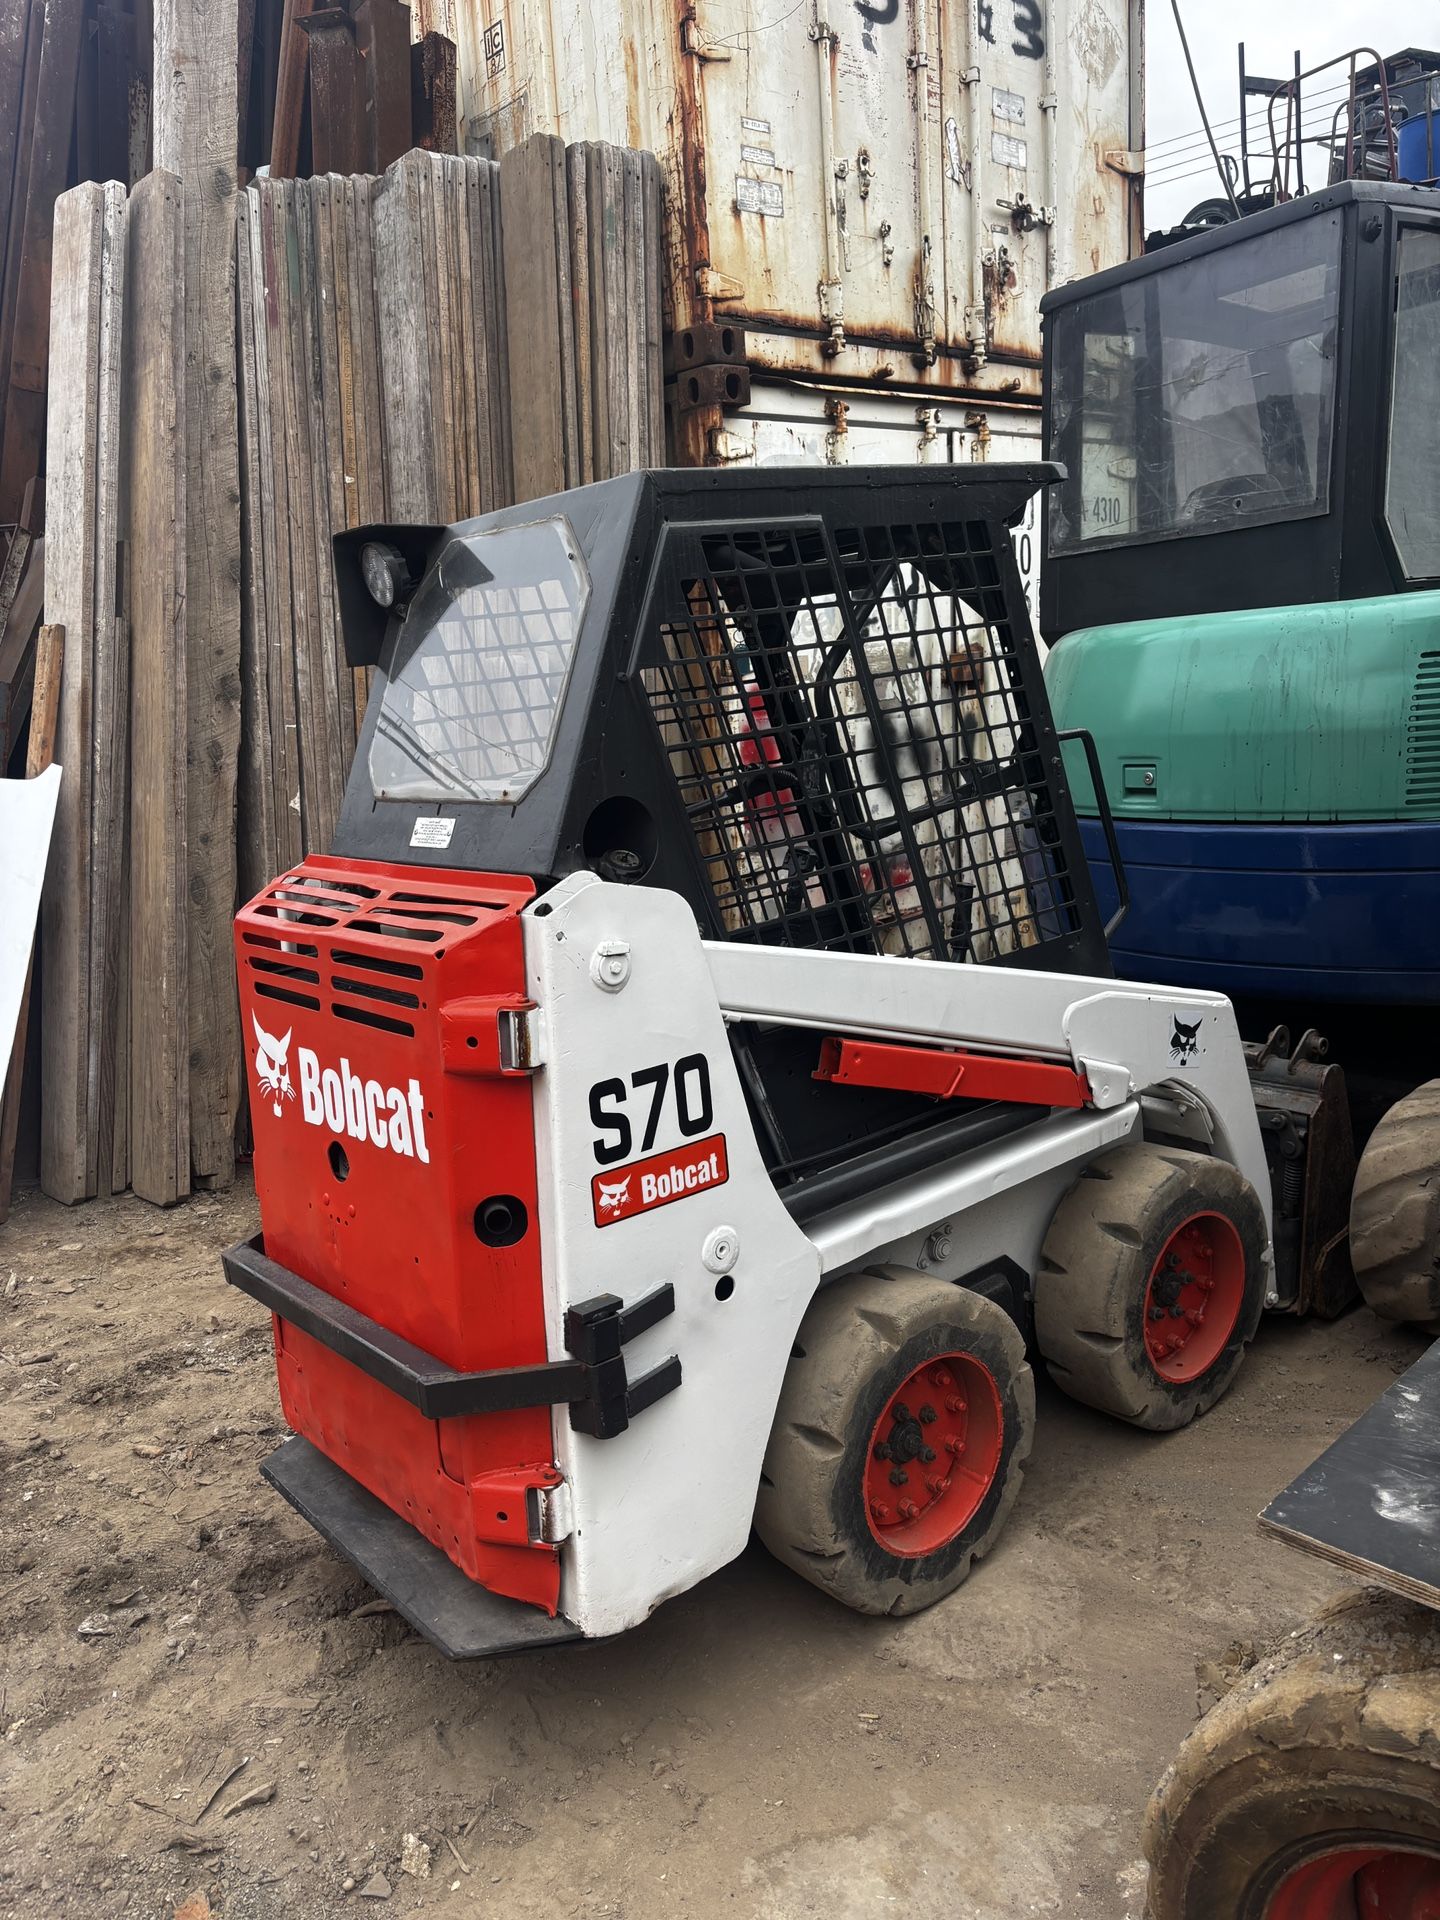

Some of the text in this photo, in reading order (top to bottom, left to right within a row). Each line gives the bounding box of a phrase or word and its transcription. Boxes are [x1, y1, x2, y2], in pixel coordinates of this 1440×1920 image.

[298, 1047, 430, 1164] Bobcat
[588, 1053, 714, 1166] S70
[640, 1152, 720, 1206] Bobcat
